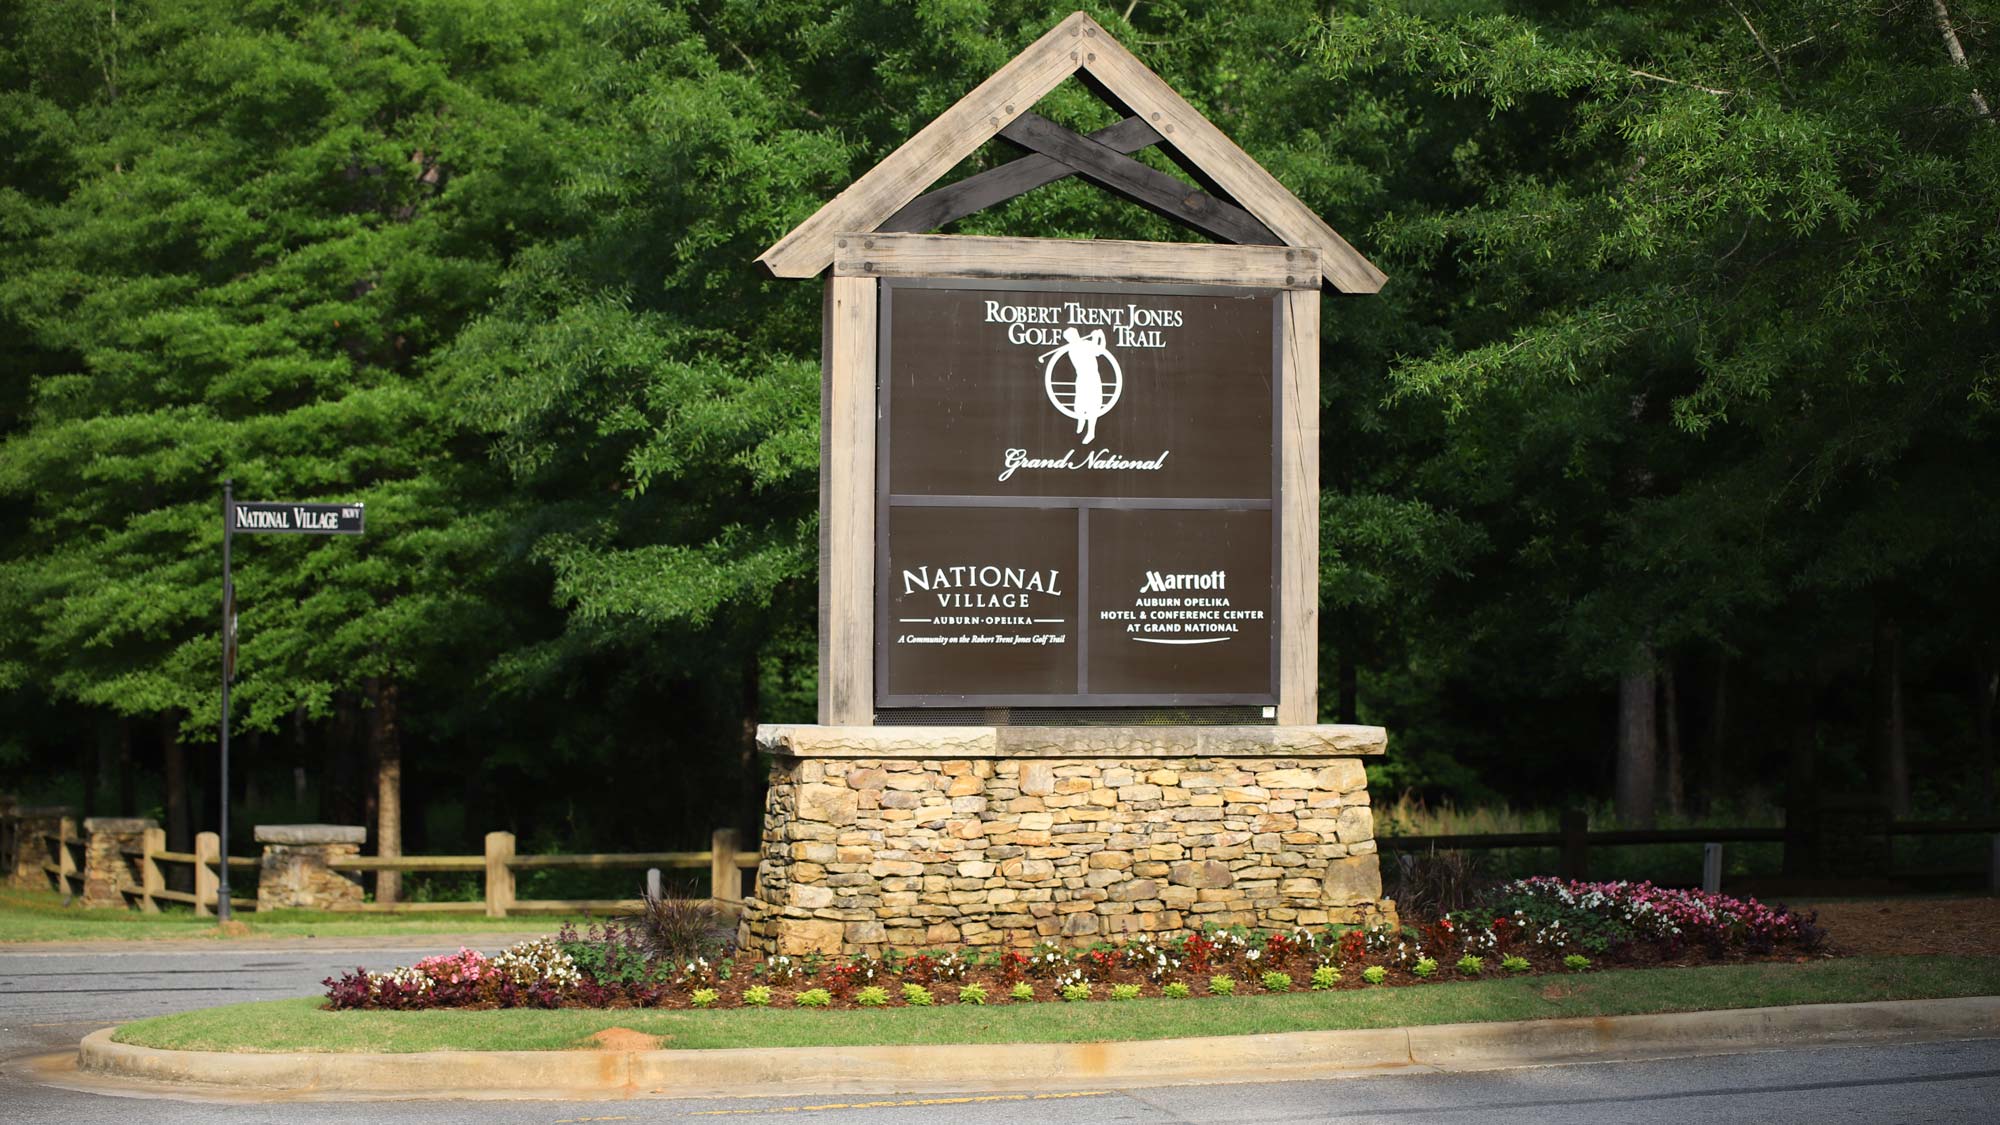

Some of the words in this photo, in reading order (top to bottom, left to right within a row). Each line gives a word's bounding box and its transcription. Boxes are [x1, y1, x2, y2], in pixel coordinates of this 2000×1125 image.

[985, 300, 1062, 324] ROBERT
[1064, 302, 1124, 326] TRENT
[1127, 304, 1183, 329] JONES
[1008, 323, 1063, 345] GOLF
[1113, 325, 1167, 348] TRAIL
[998, 448, 1075, 481] Grand
[1068, 448, 1169, 470] National
[236, 506, 290, 528] NATIONAL
[293, 507, 338, 529] VILLAGE
[902, 565, 1062, 596] NATIONAL
[1139, 570, 1226, 593] Marriott
[937, 593, 1030, 608] VILLAGE
[1135, 598, 1181, 607] AUBURN
[1184, 598, 1230, 607] OPELIKA
[1100, 610, 1136, 620] HOTEL
[1139, 611, 1147, 620] &
[1150, 611, 1220, 620] CONFERENCE
[1223, 610, 1264, 619] CENTER
[1126, 623, 1141, 632] AT
[1143, 623, 1181, 632] GRAND
[1184, 623, 1239, 632] NATIONAL
[897, 635, 906, 644] A
[907, 634, 949, 646] Community
[949, 636, 959, 644] on
[959, 634, 970, 644] the
[970, 634, 995, 644] Robert
[995, 634, 1014, 644] Trent
[1013, 634, 1031, 645] Jones
[1032, 634, 1048, 646] Golf
[1048, 634, 1066, 644] Trail
